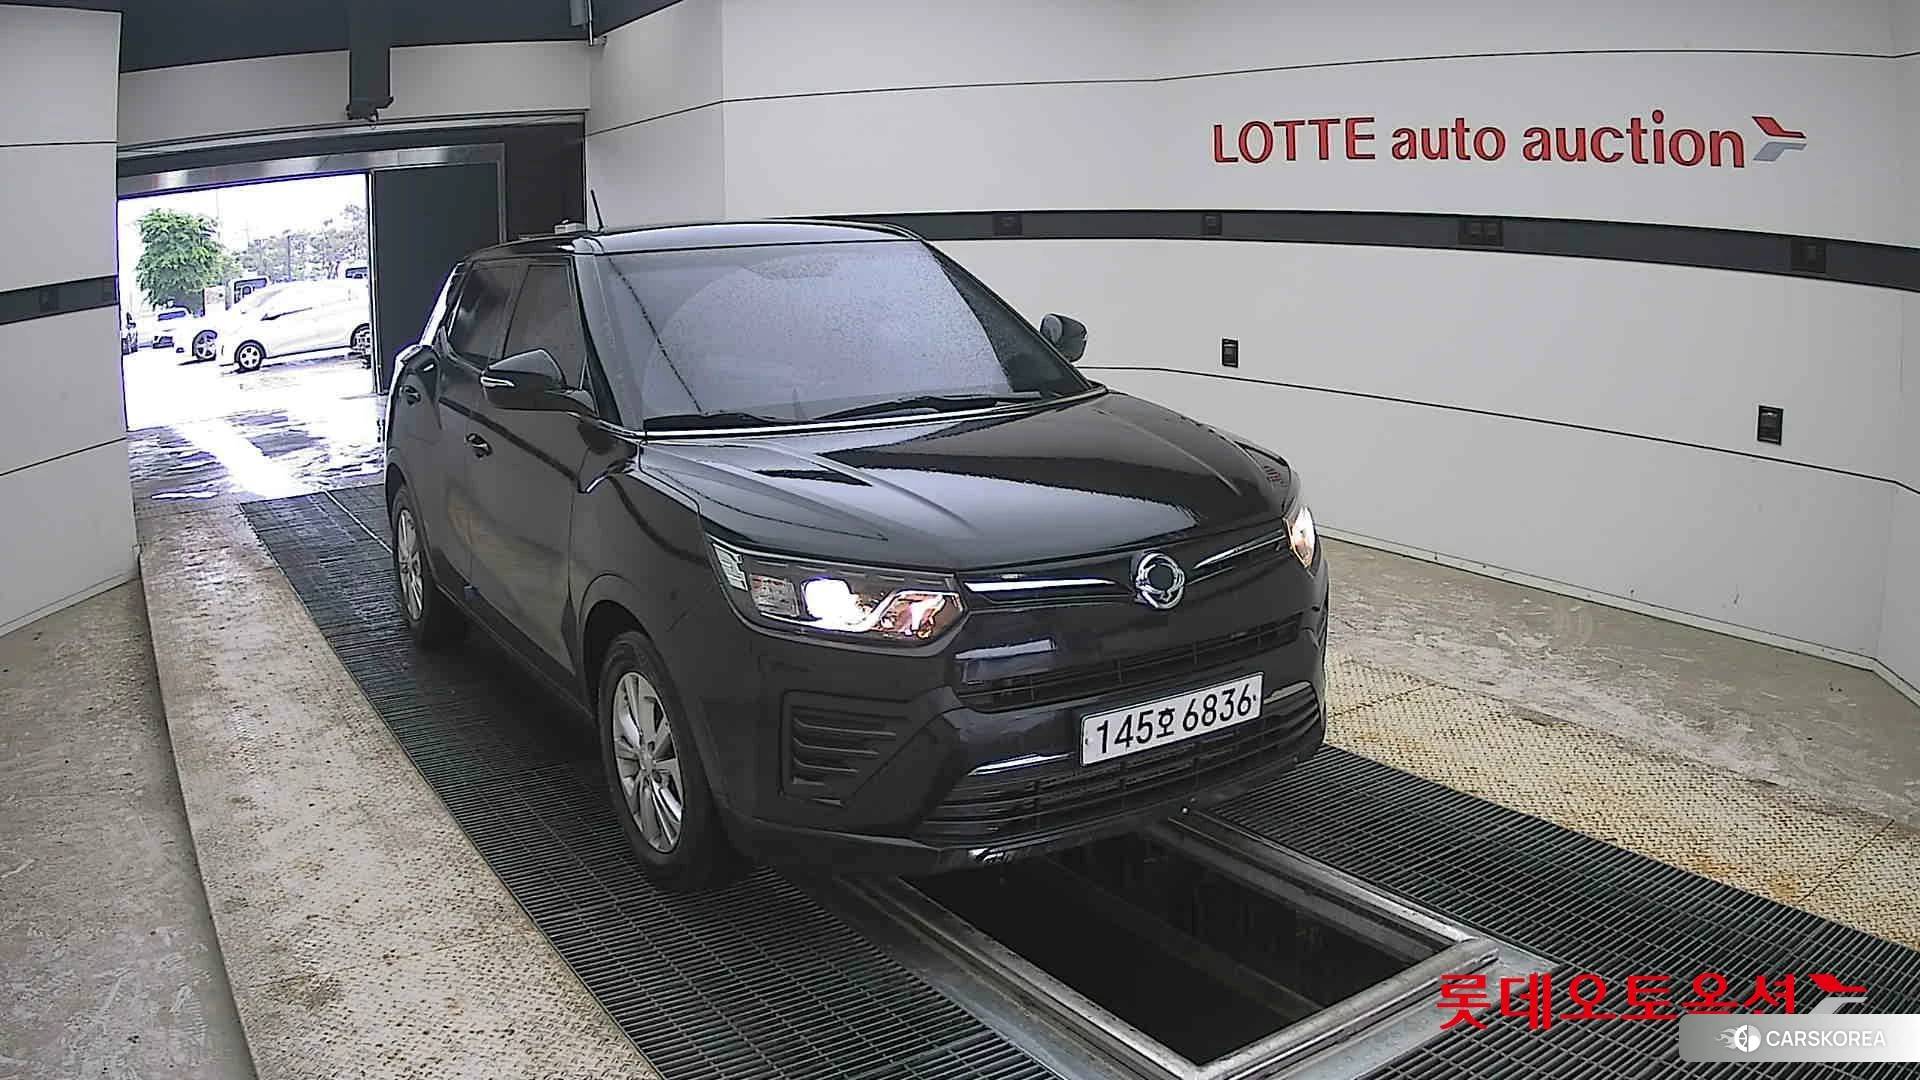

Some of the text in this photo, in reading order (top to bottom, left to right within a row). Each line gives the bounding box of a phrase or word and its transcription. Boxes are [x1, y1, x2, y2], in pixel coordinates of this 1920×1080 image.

[1212, 110, 1746, 168] LOTTE auto auction
[1096, 683, 1253, 754] 145호 6836
